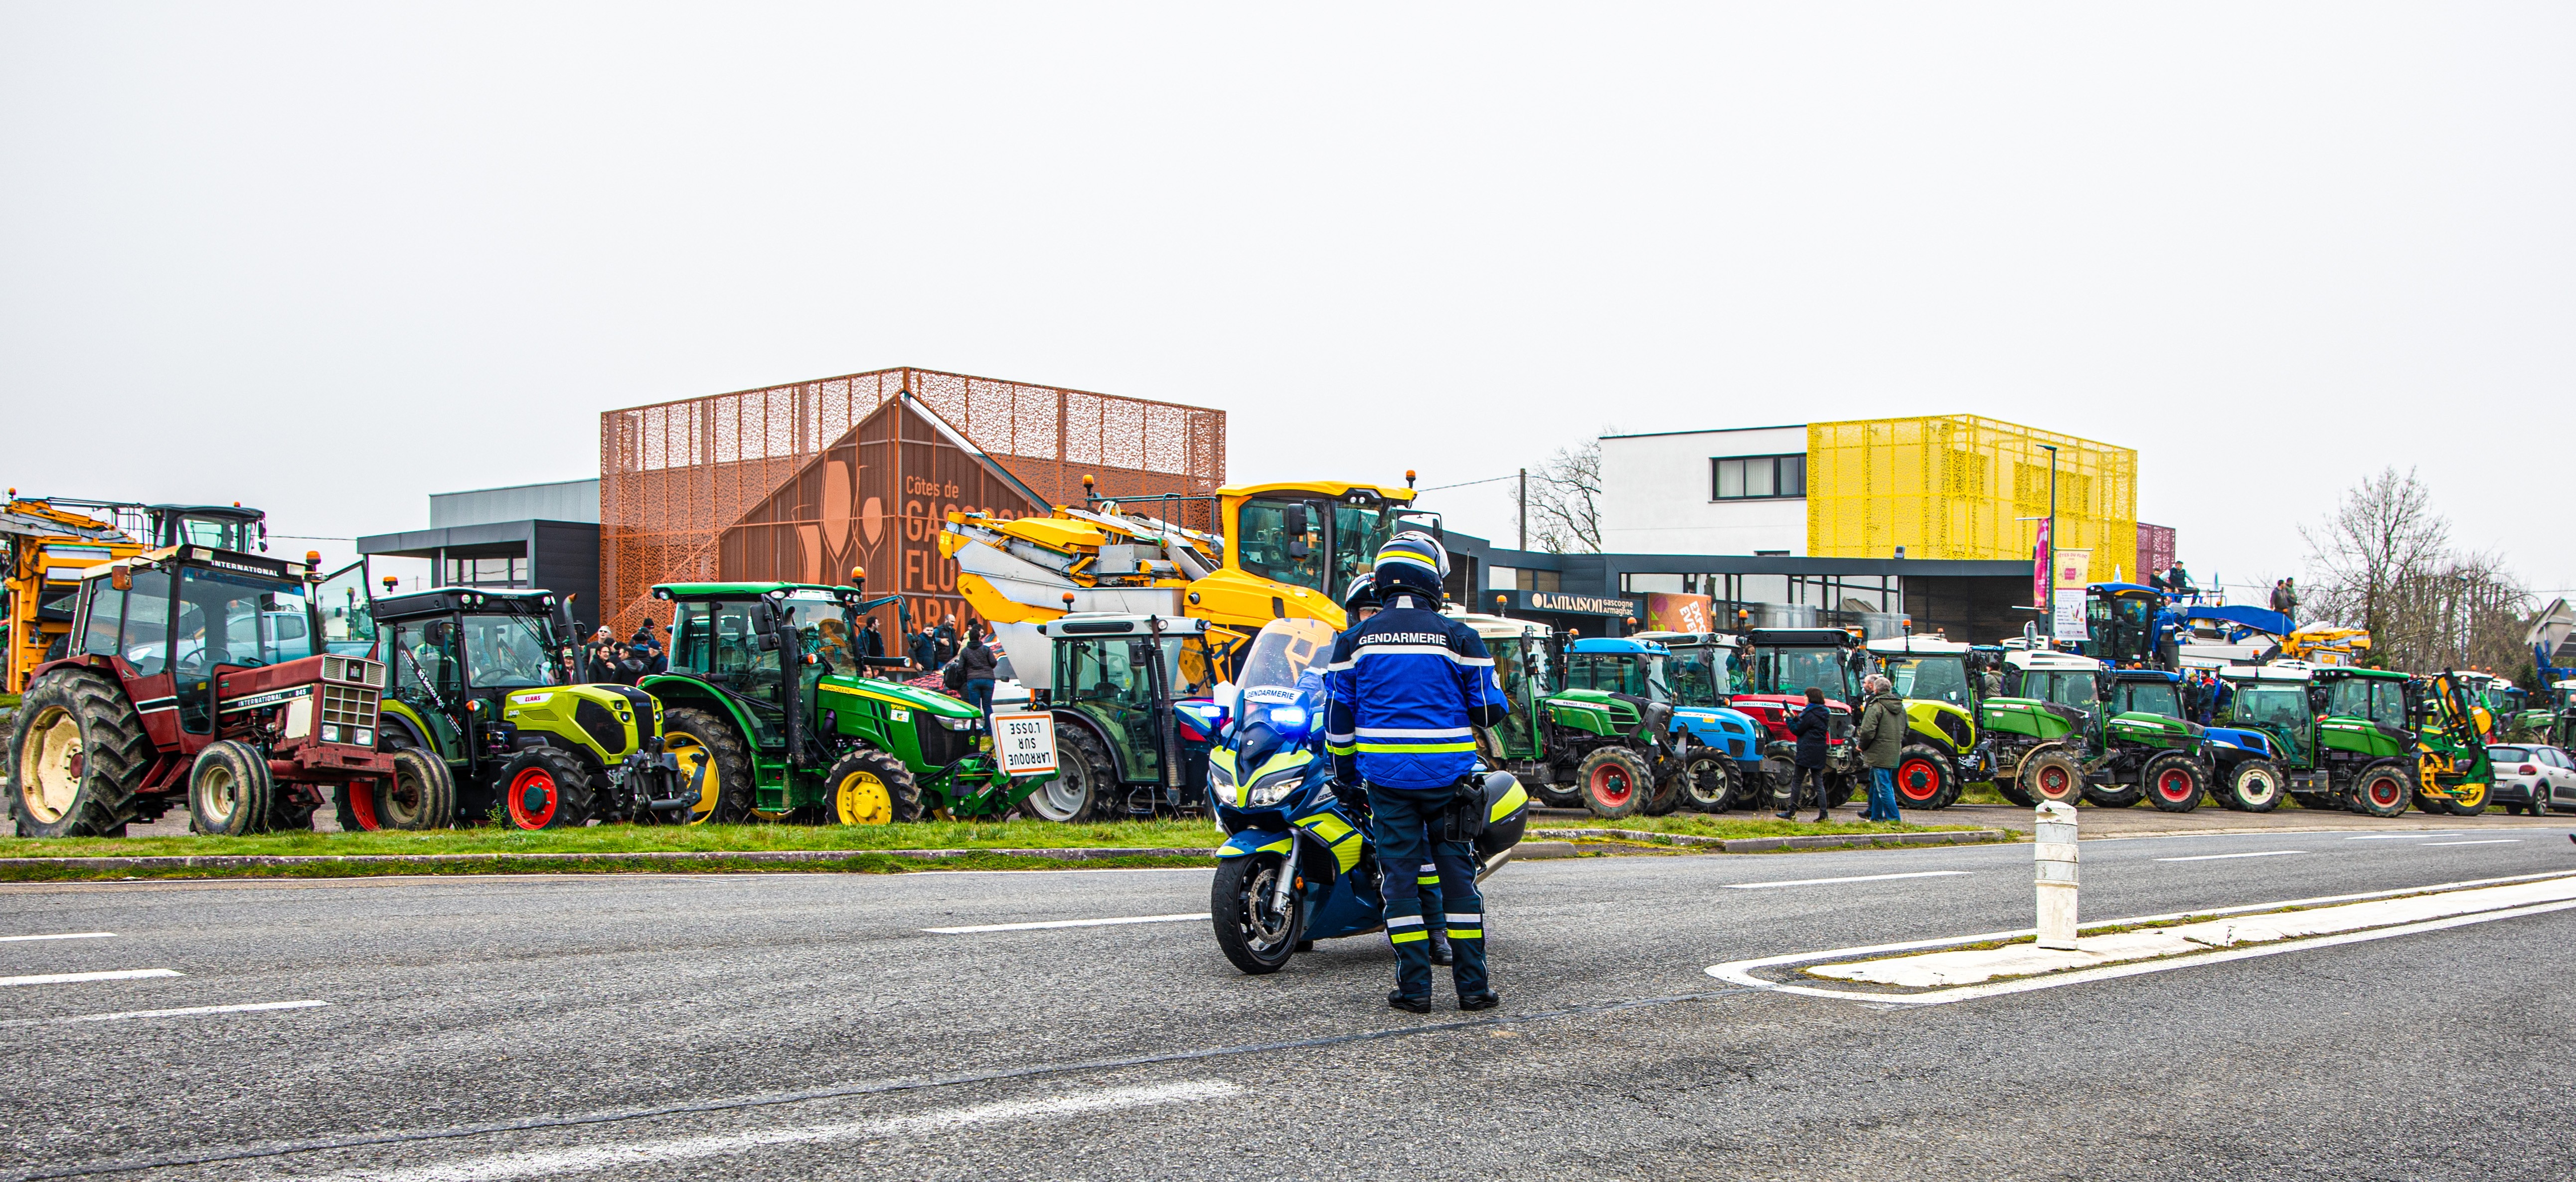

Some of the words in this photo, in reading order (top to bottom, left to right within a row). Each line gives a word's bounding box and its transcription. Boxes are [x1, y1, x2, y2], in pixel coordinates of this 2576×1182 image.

[906, 475, 940, 497] Côtes
[945, 480, 959, 498] de
[211, 560, 279, 577] INTERNATIONAL
[1359, 632, 1447, 645] GENDARMERIE
[237, 693, 283, 707] INTERNATIONAL
[1247, 690, 1294, 700] GENDARMERIE
[1010, 722, 1040, 735] L'OSSE
[1018, 738, 1036, 749] SUR
[1008, 752, 1050, 765] LARROQUE
